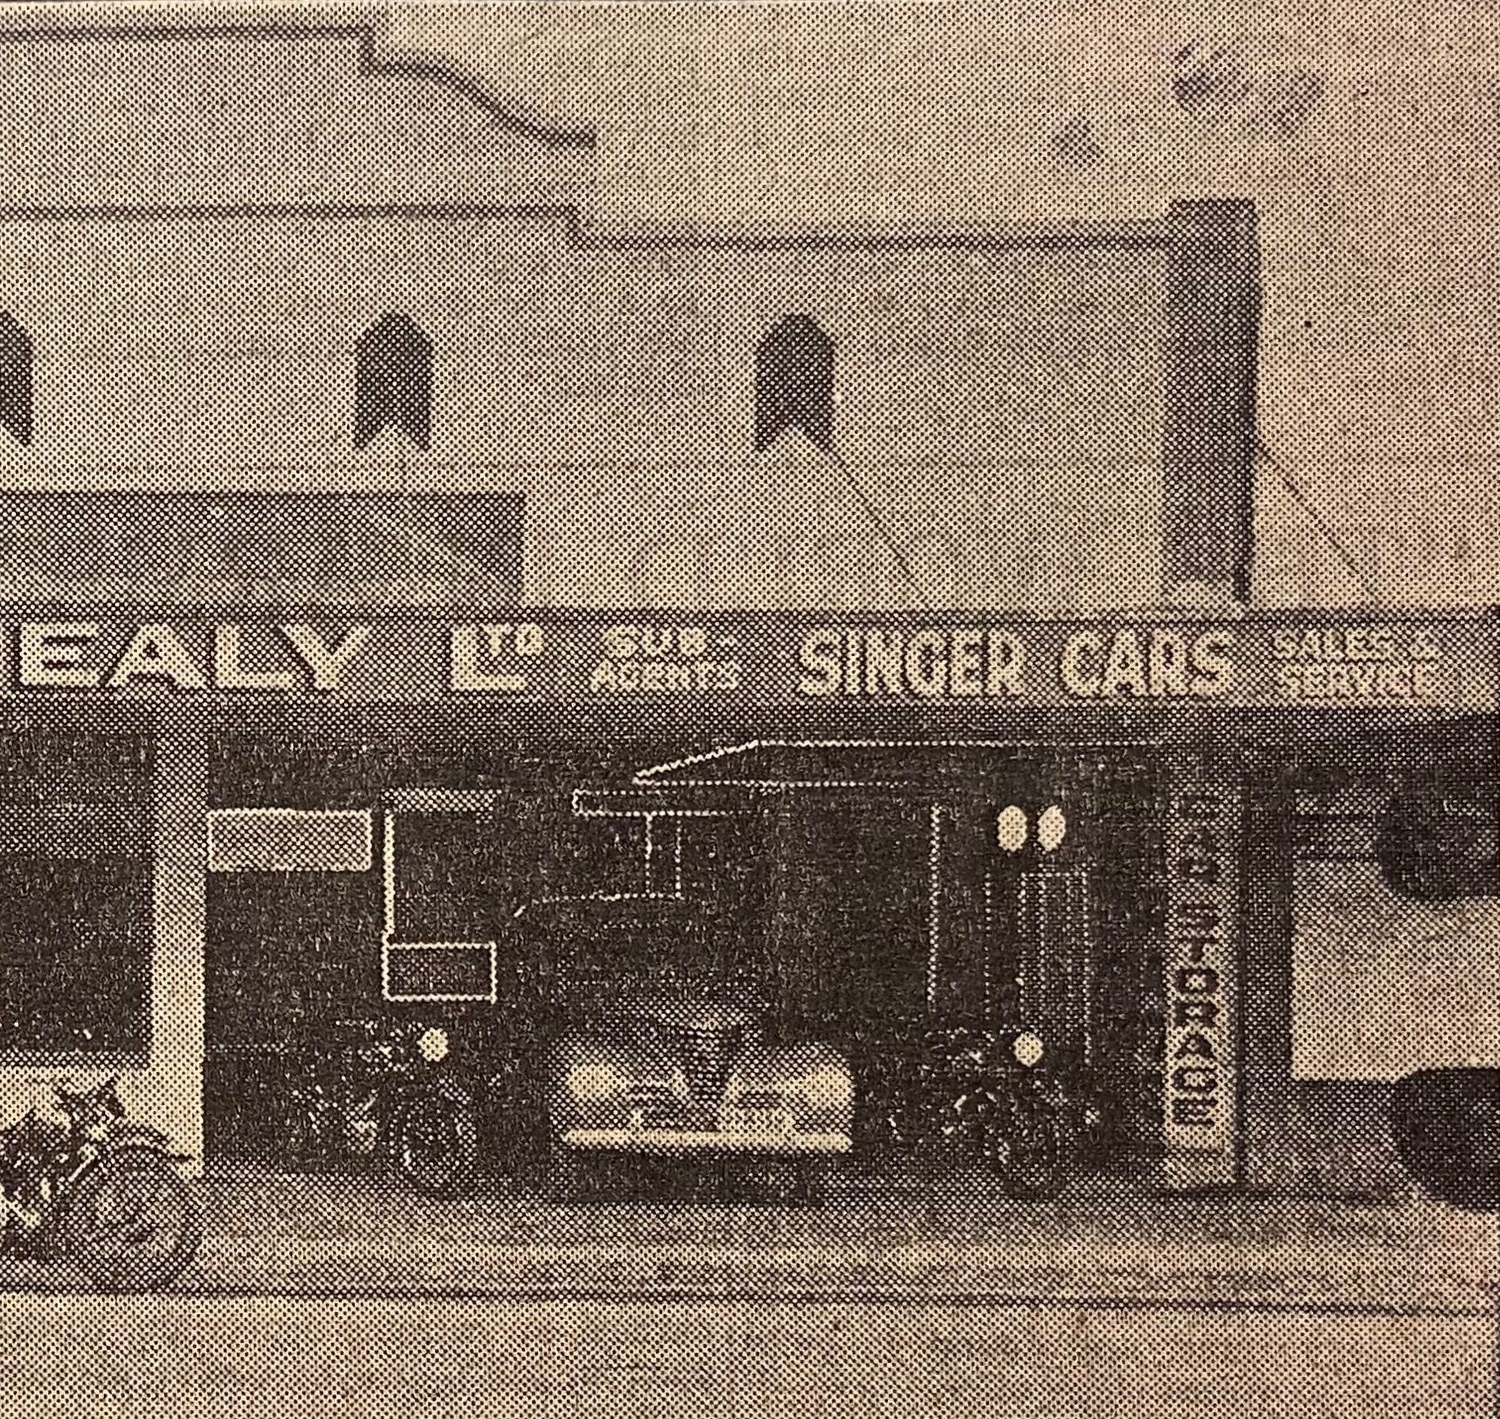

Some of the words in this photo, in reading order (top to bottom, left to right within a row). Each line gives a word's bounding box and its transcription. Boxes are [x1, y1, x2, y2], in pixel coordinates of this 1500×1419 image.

[798, 627, 1024, 698] SINGER
[1060, 628, 1236, 698] CARS
[1272, 628, 1398, 660] SALES
[590, 658, 740, 694] AGENTS
[1276, 662, 1438, 698] SERVICE
[1176, 793, 1220, 885] CAR
[1171, 902, 1220, 1130] STORAGE
